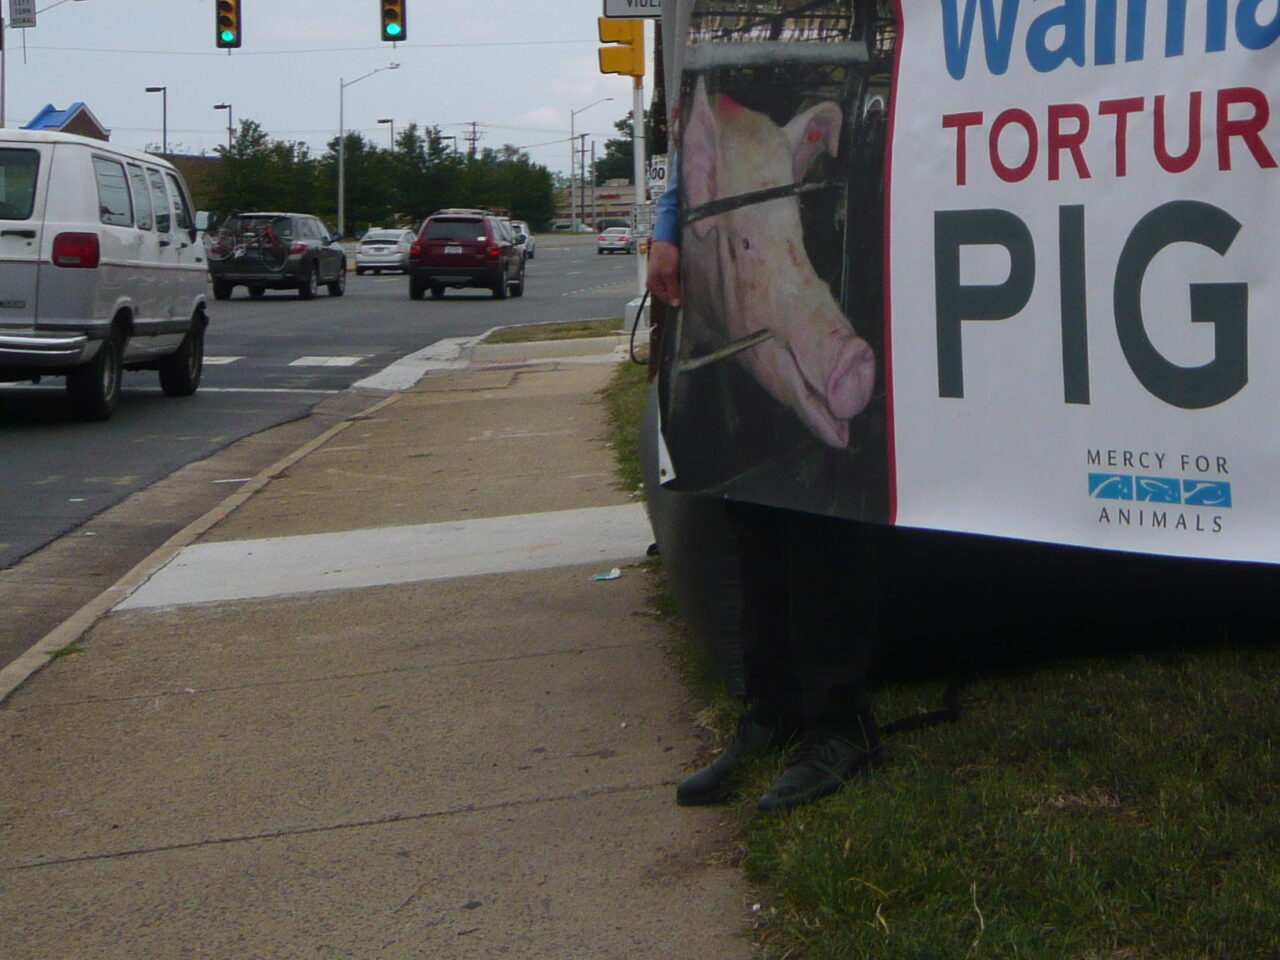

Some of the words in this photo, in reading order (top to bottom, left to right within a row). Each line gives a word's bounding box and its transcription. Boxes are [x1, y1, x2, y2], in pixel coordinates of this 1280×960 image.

[1087, 448, 1166, 471] MERCY
[1180, 454, 1230, 474] FOR
[1098, 507, 1223, 533] ANIMALS
